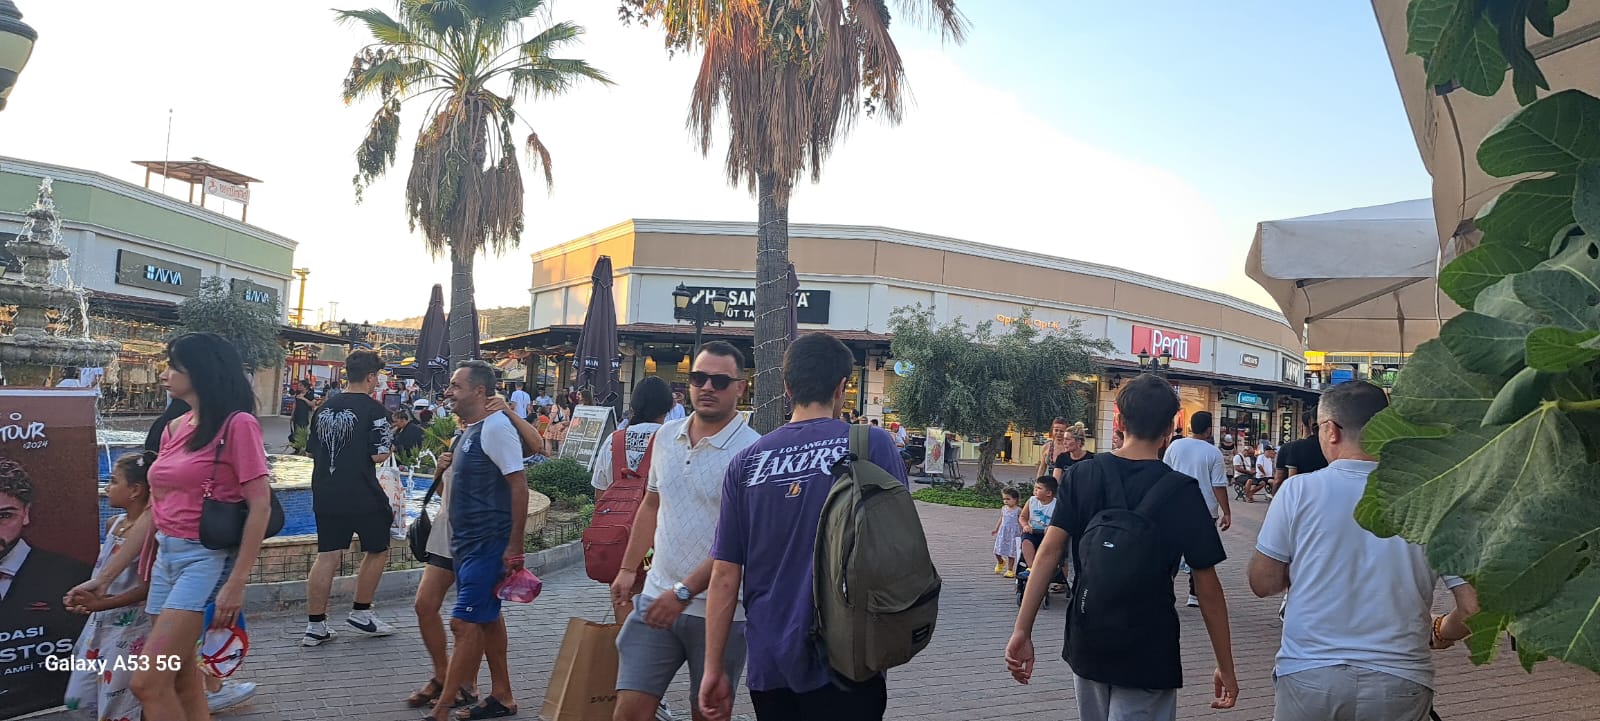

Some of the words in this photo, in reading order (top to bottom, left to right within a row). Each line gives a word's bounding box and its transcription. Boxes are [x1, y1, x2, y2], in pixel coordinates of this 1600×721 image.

[155, 267, 182, 286] AVVA
[1152, 329, 1189, 360] Penti
[0, 421, 46, 442] TOUR
[779, 445, 799, 454] LOS
[799, 437, 849, 451] ANGELES
[0, 638, 73, 663] STOS
